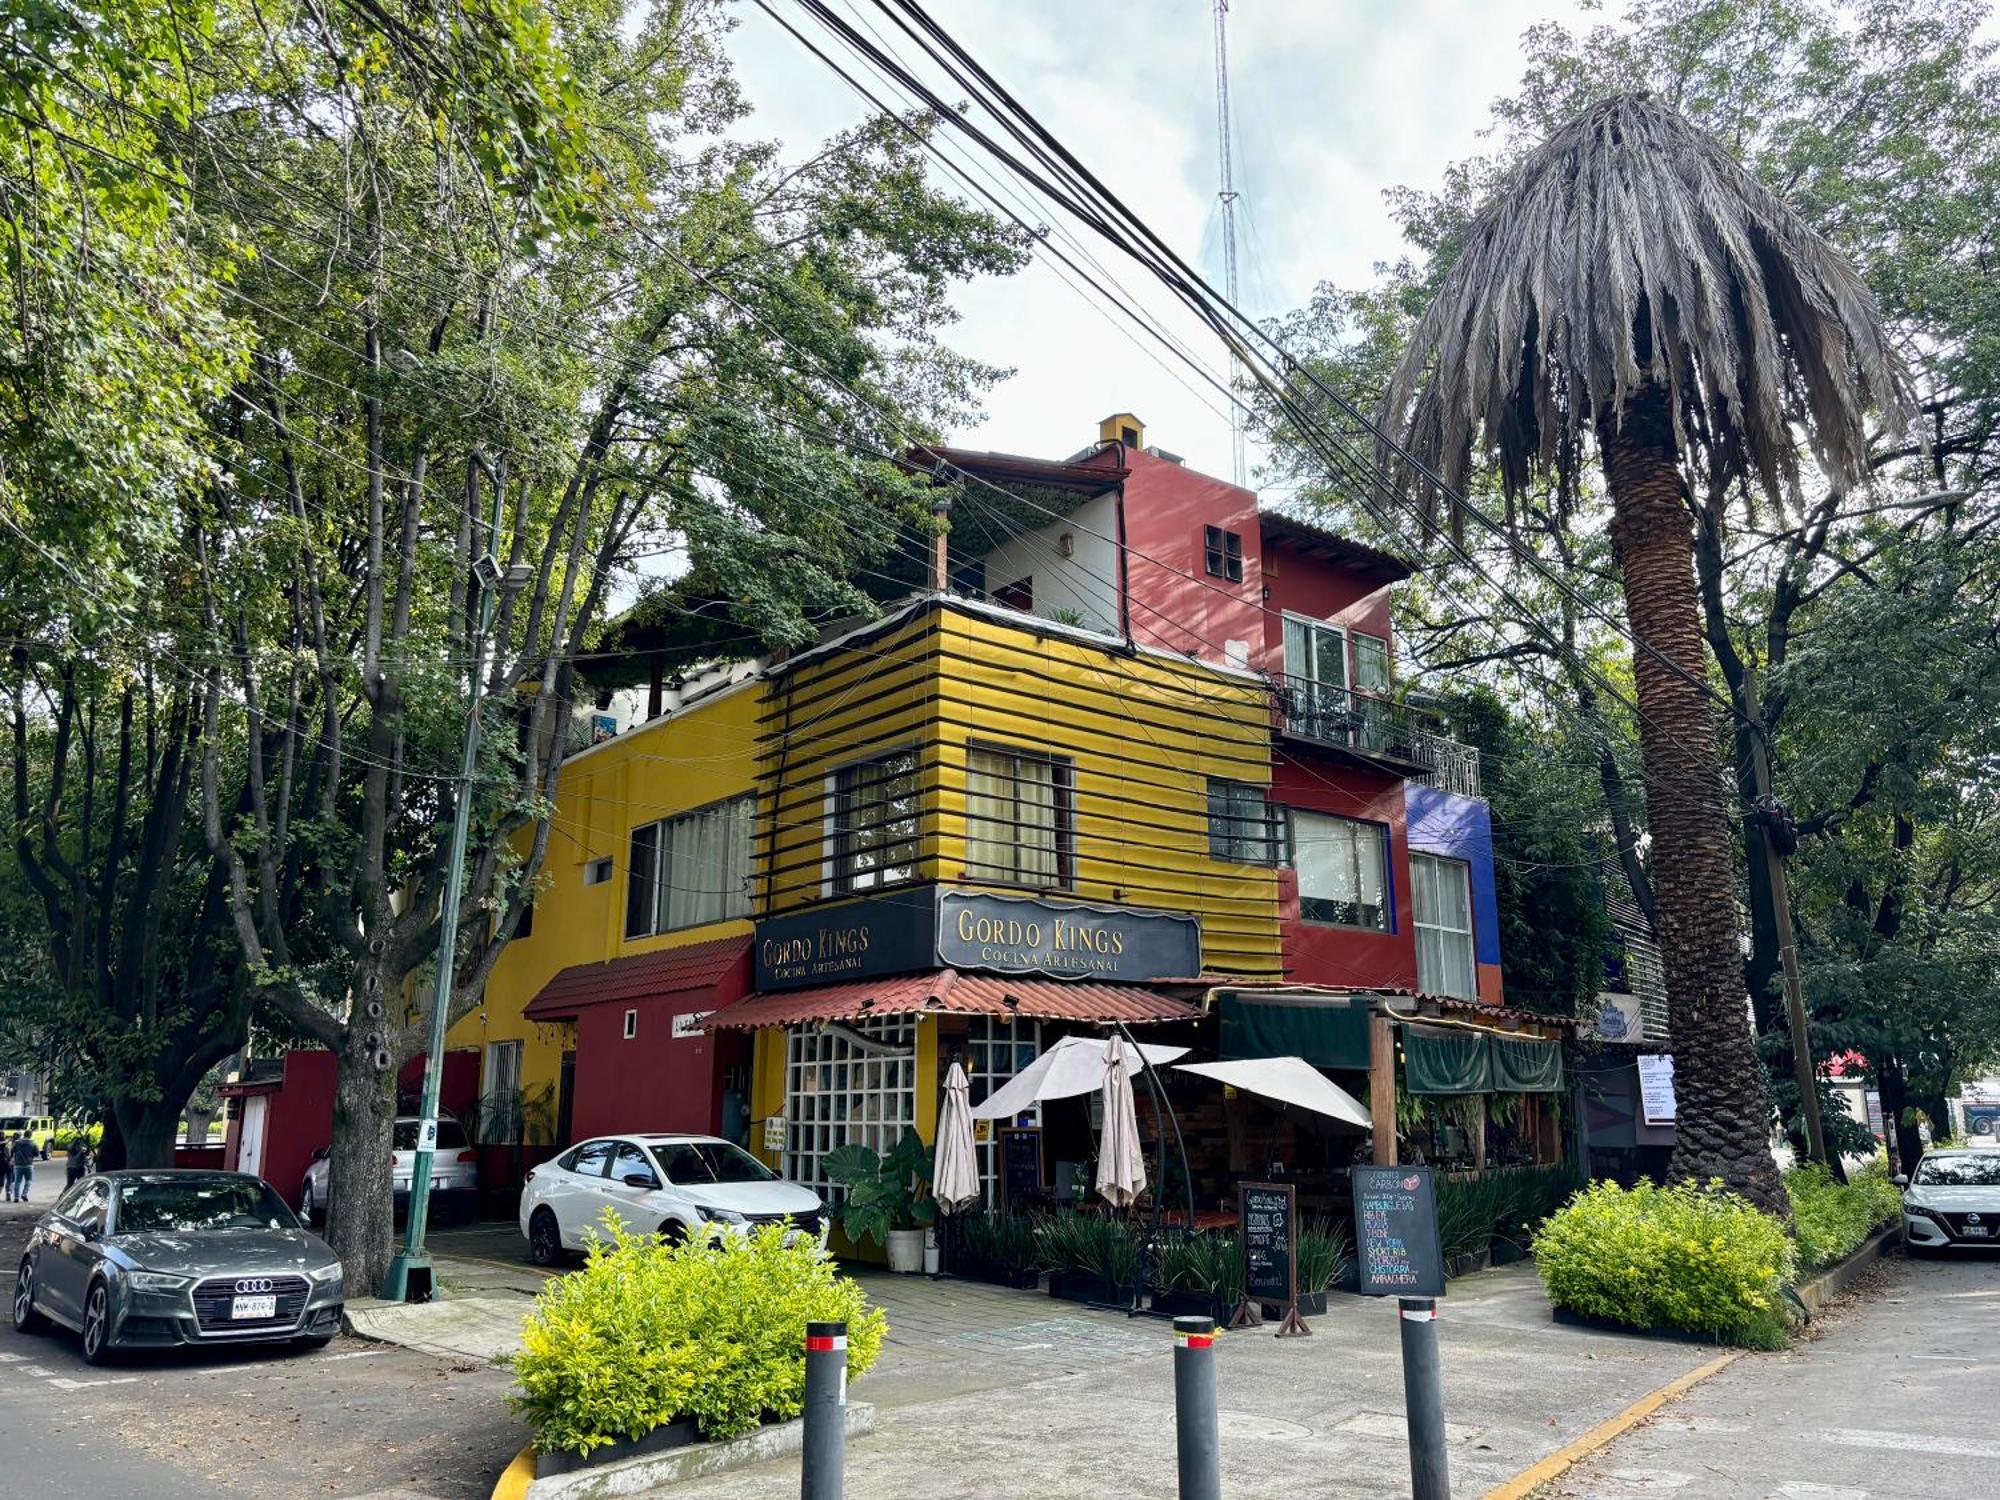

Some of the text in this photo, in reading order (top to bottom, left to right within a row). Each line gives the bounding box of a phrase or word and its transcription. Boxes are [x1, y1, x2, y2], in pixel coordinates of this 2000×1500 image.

[763, 927, 870, 968] GORDO KINGS
[959, 909, 1123, 955] GORDO KINGS
[775, 957, 862, 979] COCINA ARTESANAL
[982, 947, 1119, 972] COCINA ARTESANAL
